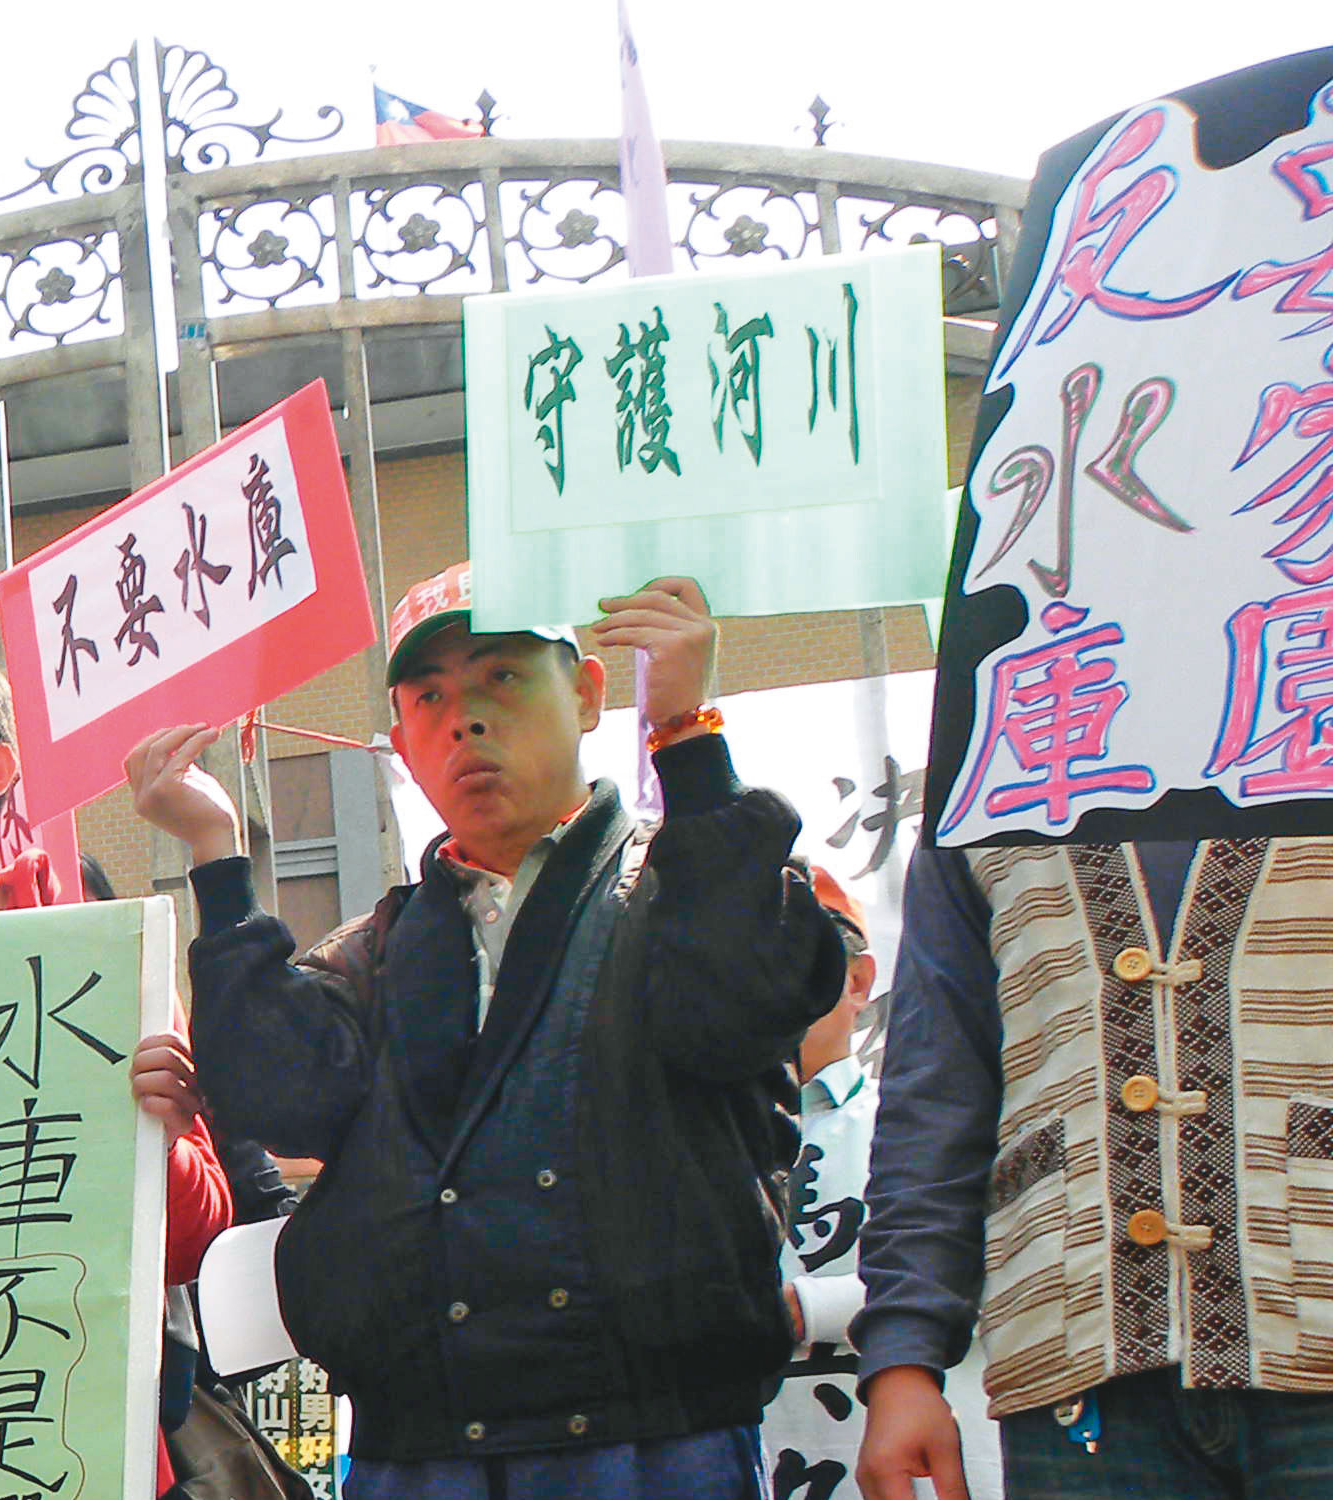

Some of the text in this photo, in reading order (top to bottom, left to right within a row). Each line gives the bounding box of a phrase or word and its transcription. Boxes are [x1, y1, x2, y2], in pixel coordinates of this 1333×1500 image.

[524, 282, 860, 497] 守護河川
[937, 105, 1241, 838] 反水庫
[53, 454, 298, 697] 不要水庫
